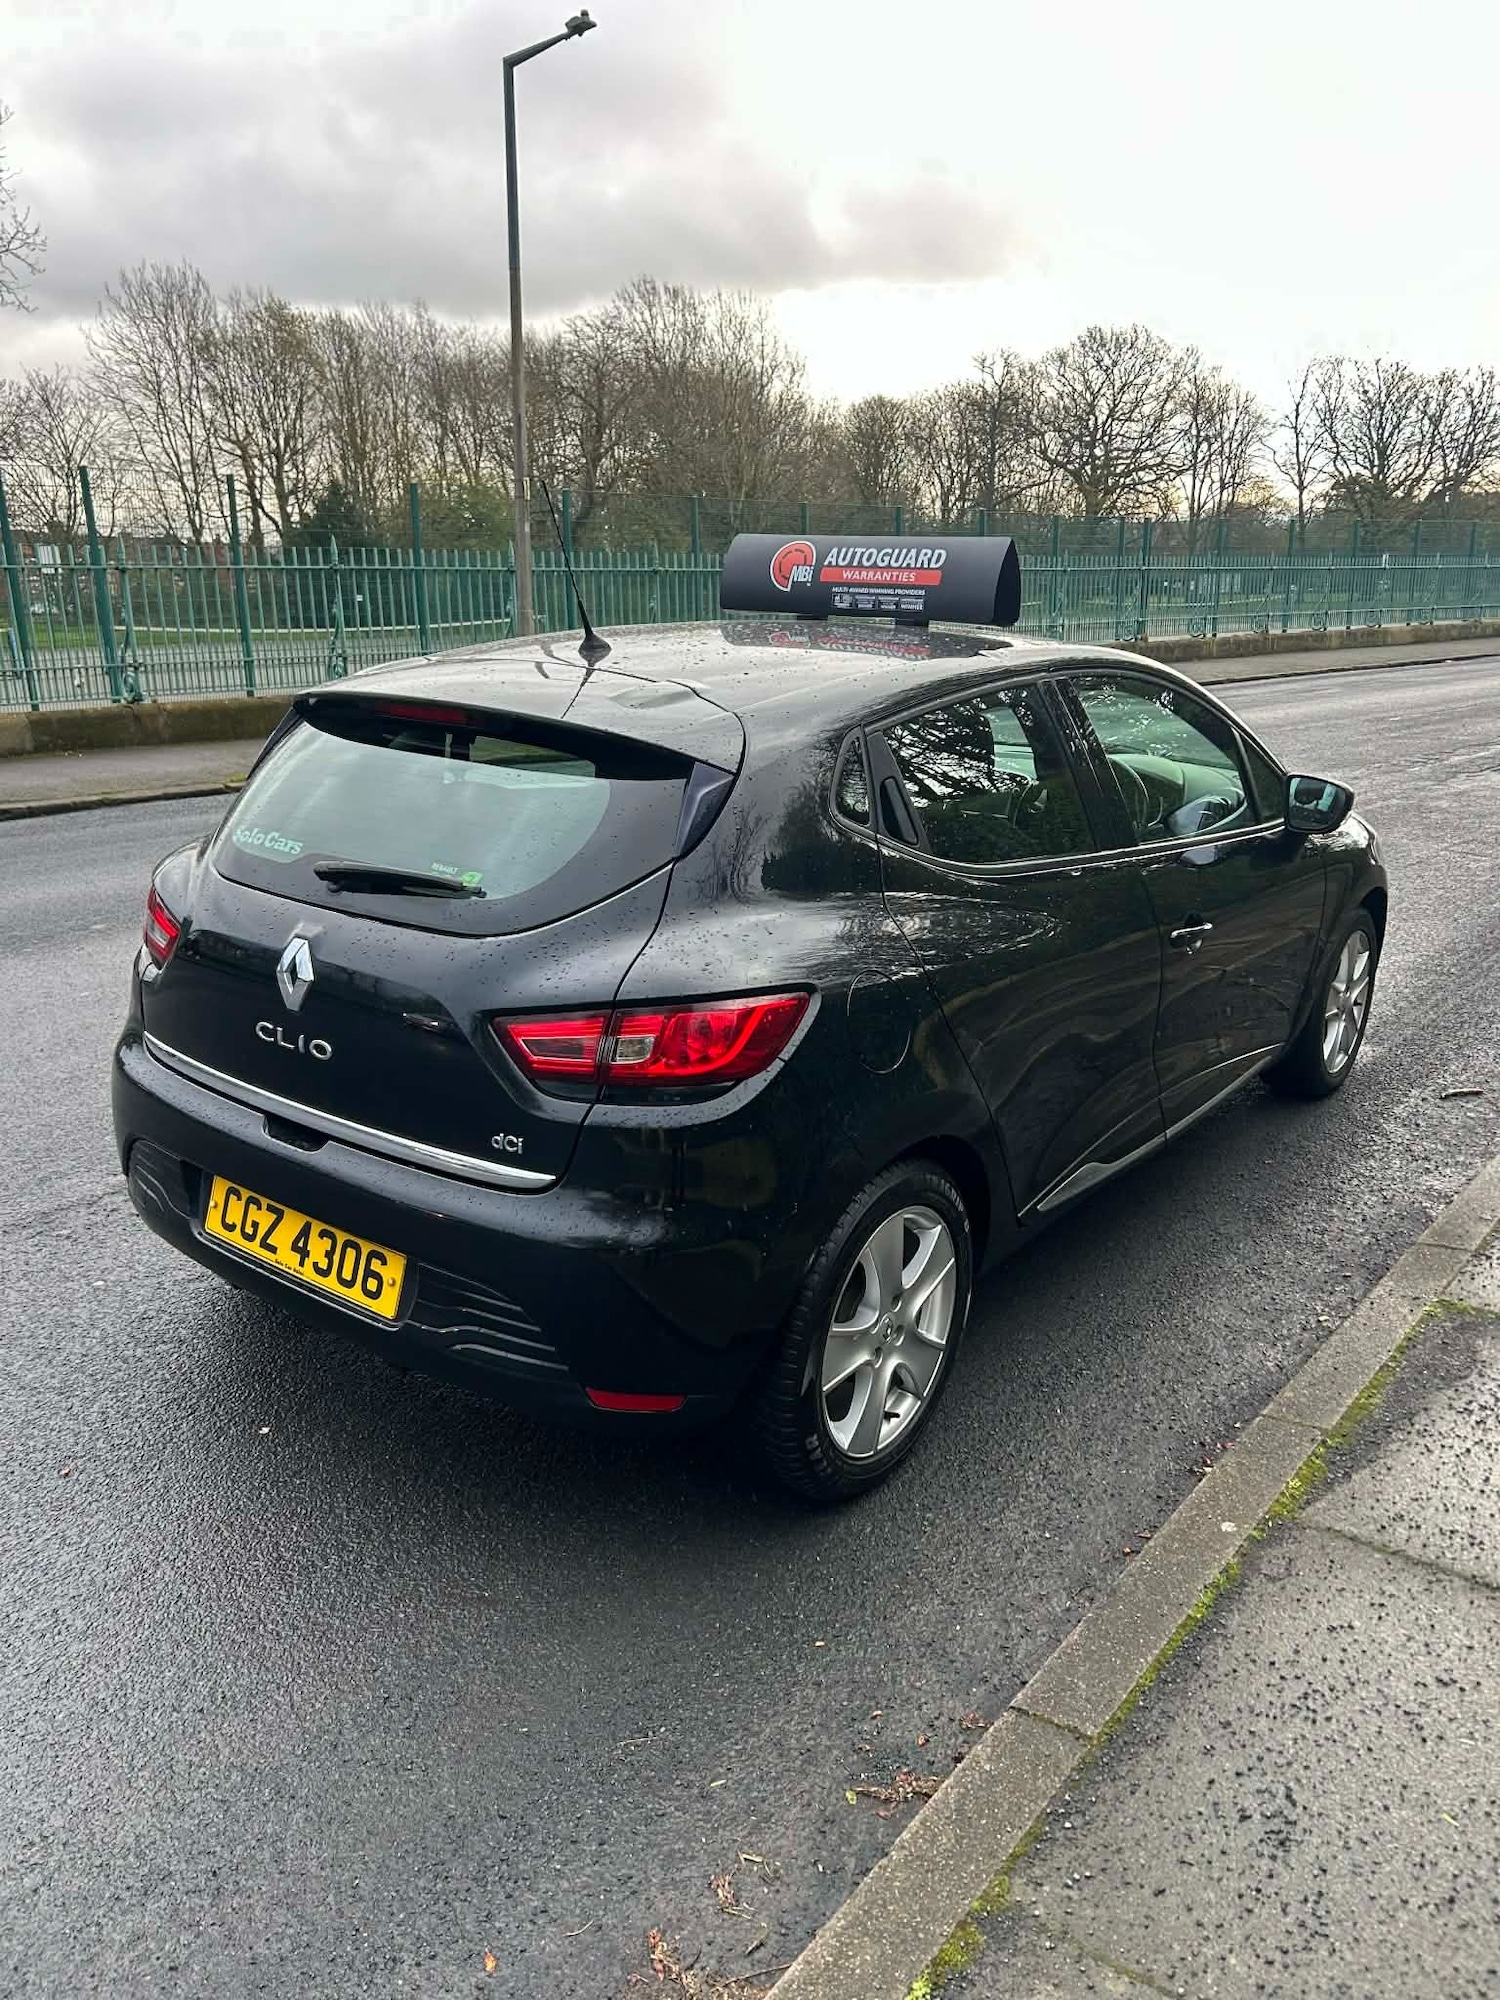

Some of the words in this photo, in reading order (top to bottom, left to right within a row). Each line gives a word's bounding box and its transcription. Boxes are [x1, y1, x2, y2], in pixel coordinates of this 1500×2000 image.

[823, 547, 948, 569] AUTOGUARD
[842, 569, 917, 583] WARRANTIES
[254, 1020, 334, 1061] CLIO
[220, 1186, 287, 1256] CGZ
[290, 1221, 389, 1301] 4306
